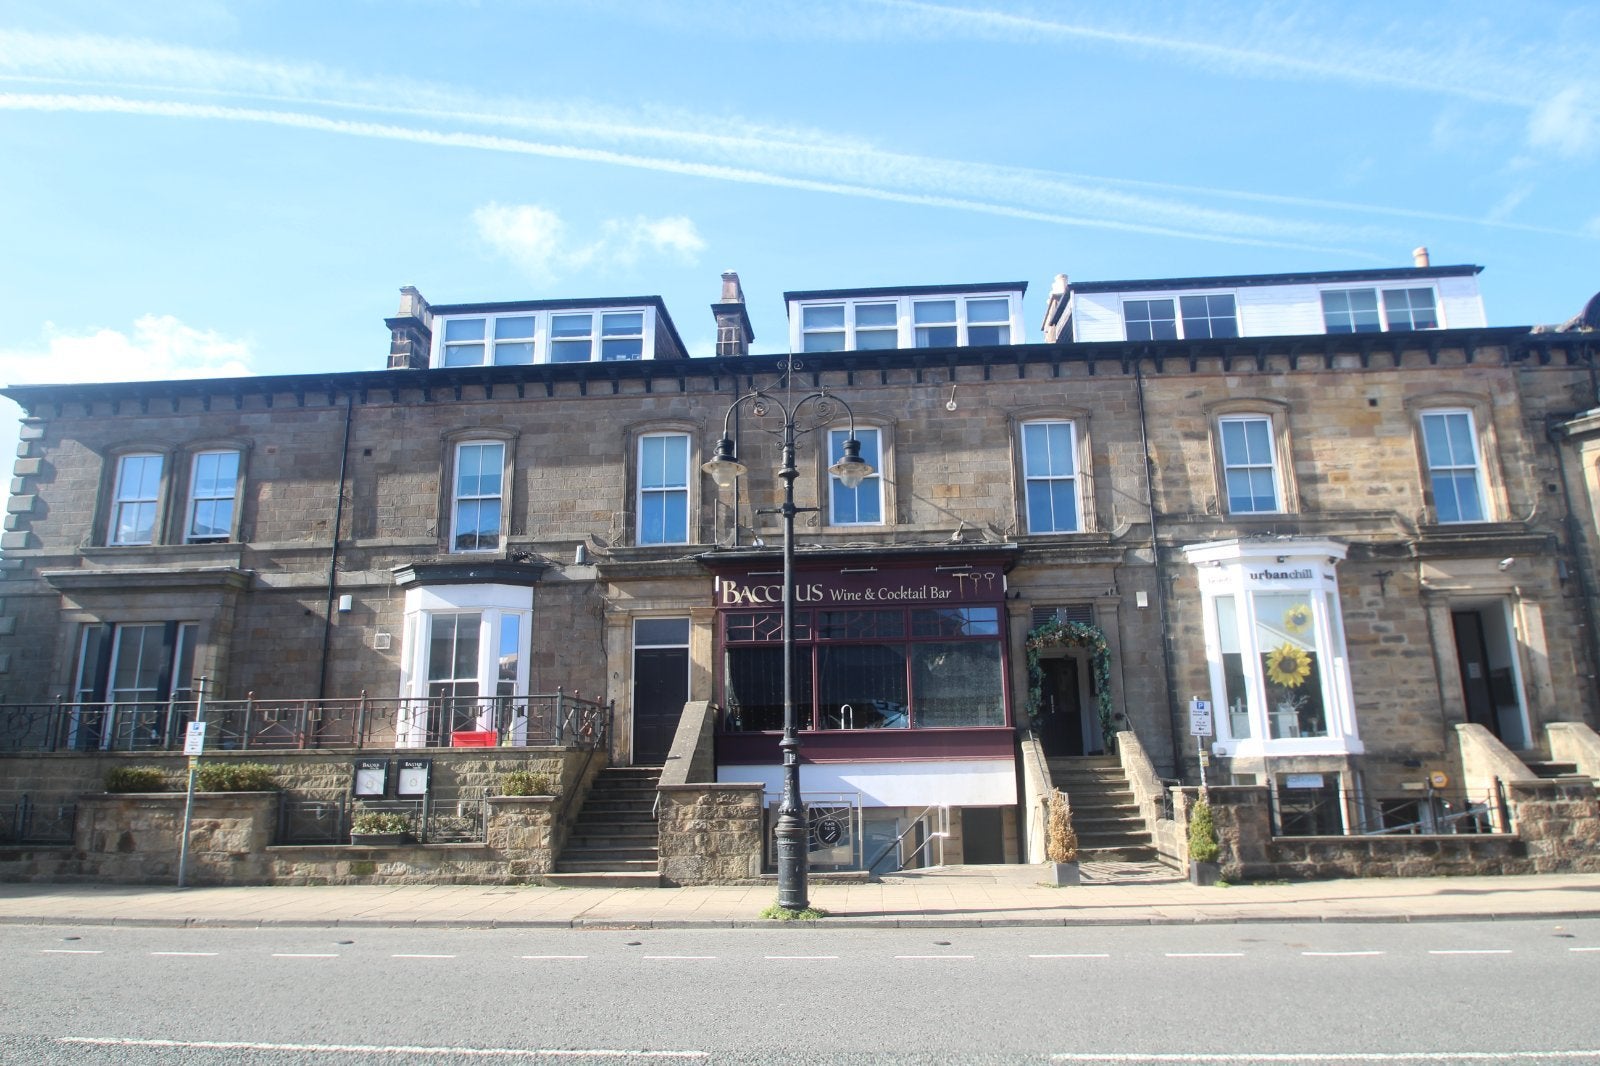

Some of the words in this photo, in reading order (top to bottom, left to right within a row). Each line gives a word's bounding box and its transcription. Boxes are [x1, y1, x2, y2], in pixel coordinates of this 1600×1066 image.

[1249, 569, 1313, 580] urbanchill
[721, 580, 824, 604] BACCUS
[829, 588, 862, 601] Wine
[864, 588, 876, 601] &
[877, 584, 927, 601] Cocktail
[930, 585, 952, 600] Bar
